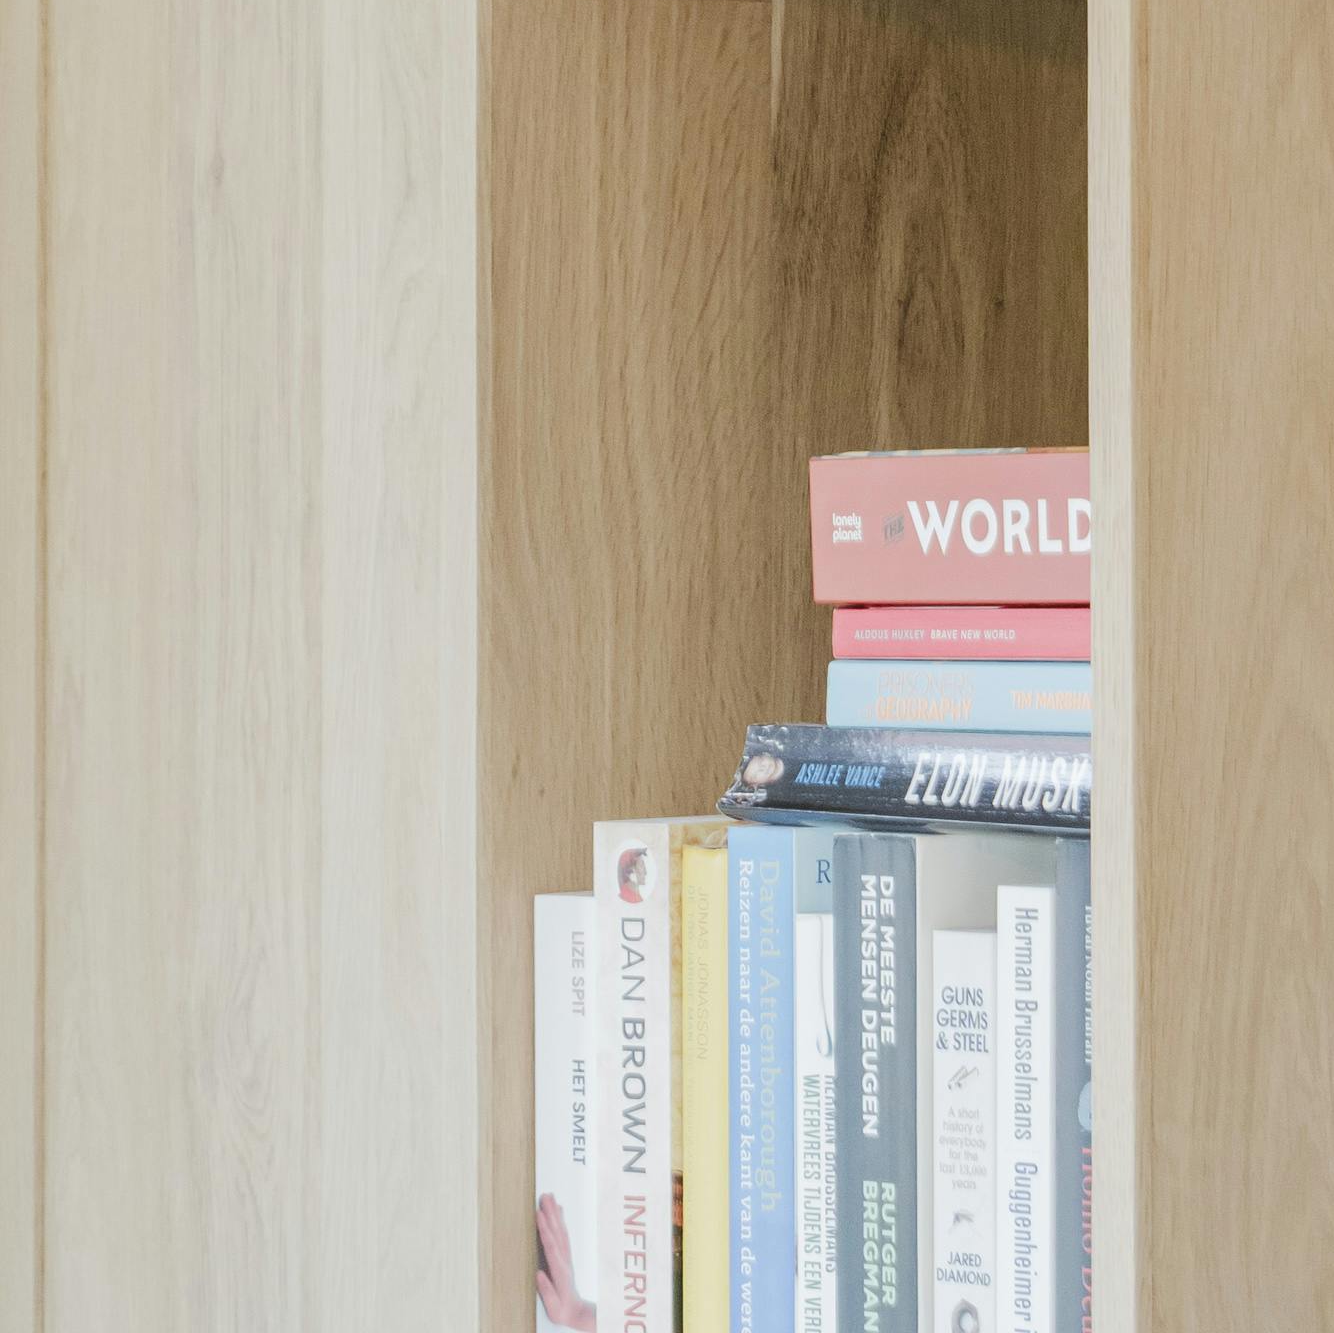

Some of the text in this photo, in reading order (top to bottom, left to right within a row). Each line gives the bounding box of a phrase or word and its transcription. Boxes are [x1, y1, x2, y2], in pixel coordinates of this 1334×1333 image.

[832, 512, 862, 530] lonely
[832, 527, 864, 544] planet
[906, 497, 1091, 556] WORLD
[855, 629, 1016, 641] ALDOUS HUXLEY BRAVE NEW WORLD
[1010, 690, 1032, 710] TIM
[795, 763, 886, 789] ASHLEE VANCE
[903, 751, 1091, 814] ELON MUSK
[739, 859, 754, 939] Reizen
[620, 917, 645, 1002] DAN
[697, 885, 710, 1061] JONAS JONASSON
[739, 947, 751, 1002] naar
[879, 875, 896, 1045] DE MEESTE
[1014, 907, 1039, 993] Herman
[861, 874, 880, 1138] MENSEN DEUGEN
[936, 1008, 989, 1030] GERMS
[941, 985, 984, 1007] GUNS
[739, 1008, 754, 1038] de
[755, 859, 782, 1212] David Attenborough
[936, 1030, 989, 1053] & STEEL
[571, 931, 587, 1166] LIZE SPIT HET SMELT
[1014, 999, 1039, 1141] Brusselmans
[621, 1017, 647, 1174] BROWN
[740, 1043, 755, 1127] andere
[803, 1074, 821, 1180] WATERVREES
[942, 1121, 984, 1134] history of
[947, 1105, 981, 1119] A short
[740, 1134, 755, 1188] kant
[939, 1135, 986, 1151] everybody
[939, 1162, 956, 1173] last
[948, 1148, 979, 1162] for the
[951, 1179, 977, 1190] years
[740, 1195, 752, 1239] van
[804, 1187, 822, 1254] TIJDENS
[740, 1247, 756, 1275] de
[862, 1180, 880, 1333] BREGMAN
[881, 1182, 896, 1308] RUTGER
[947, 1251, 983, 1268] JARED
[1009, 1161, 1038, 1323] Guggenheimer
[804, 1261, 822, 1290] EEN
[936, 1267, 992, 1286] DIAMOND
